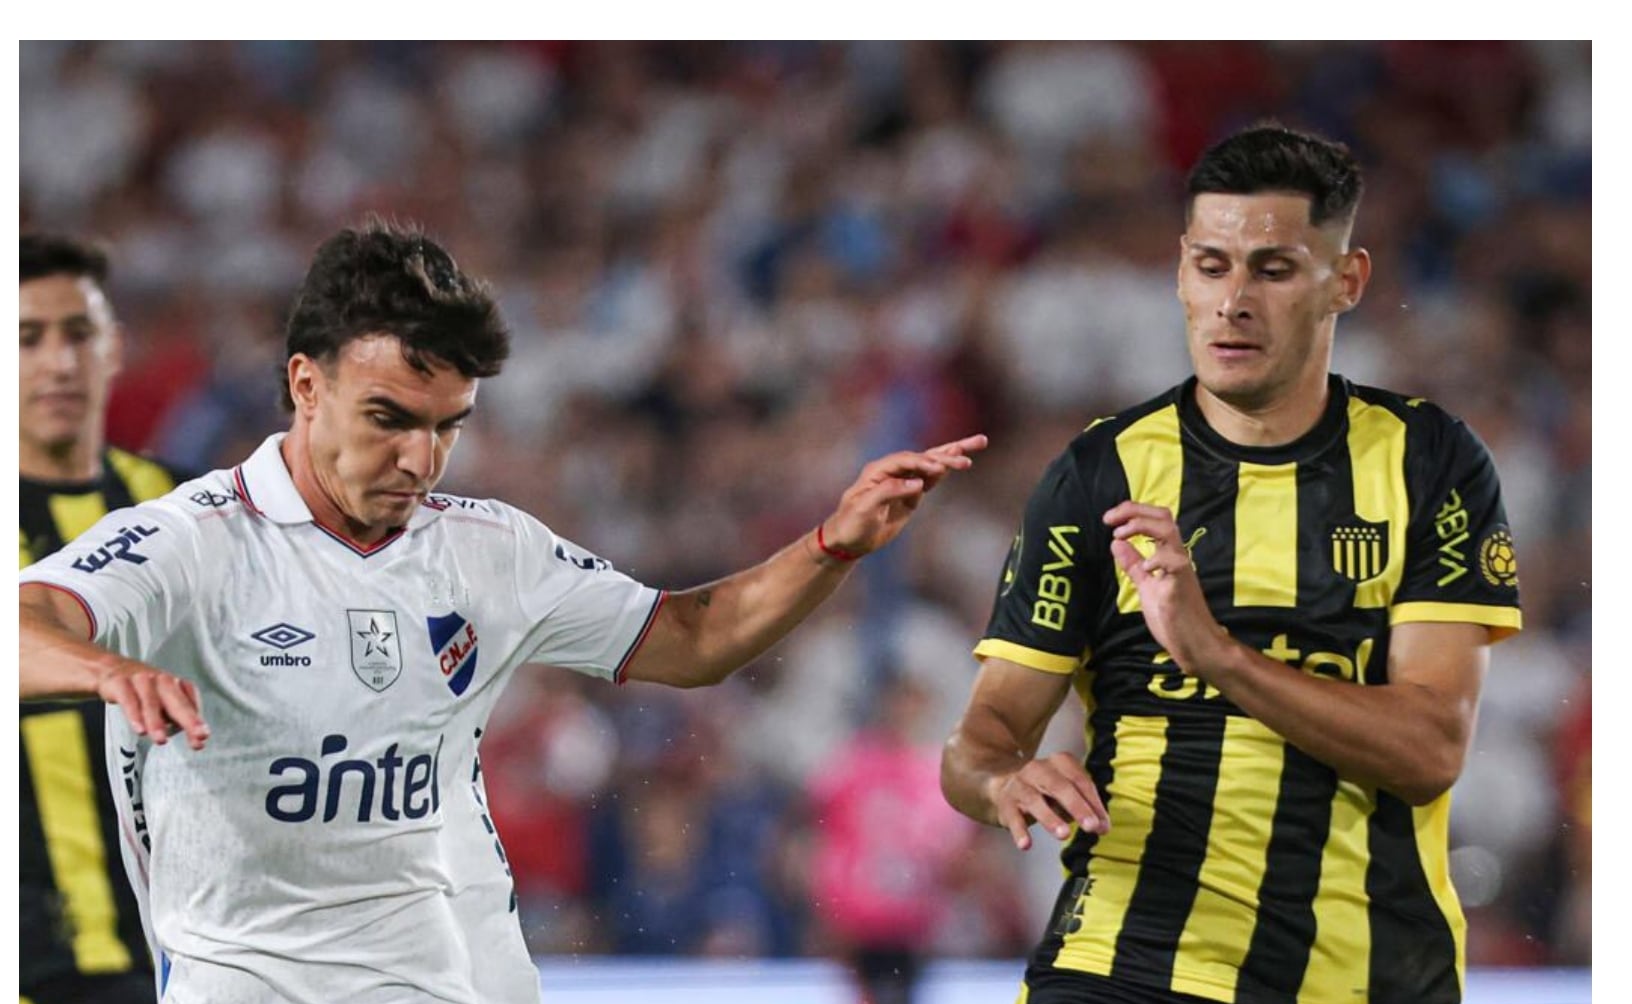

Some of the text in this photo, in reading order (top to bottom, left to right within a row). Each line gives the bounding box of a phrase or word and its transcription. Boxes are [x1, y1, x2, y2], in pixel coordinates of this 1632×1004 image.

[1031, 525, 1081, 632] BBVA
[260, 653, 311, 667] umbro
[265, 734, 444, 824] antel
